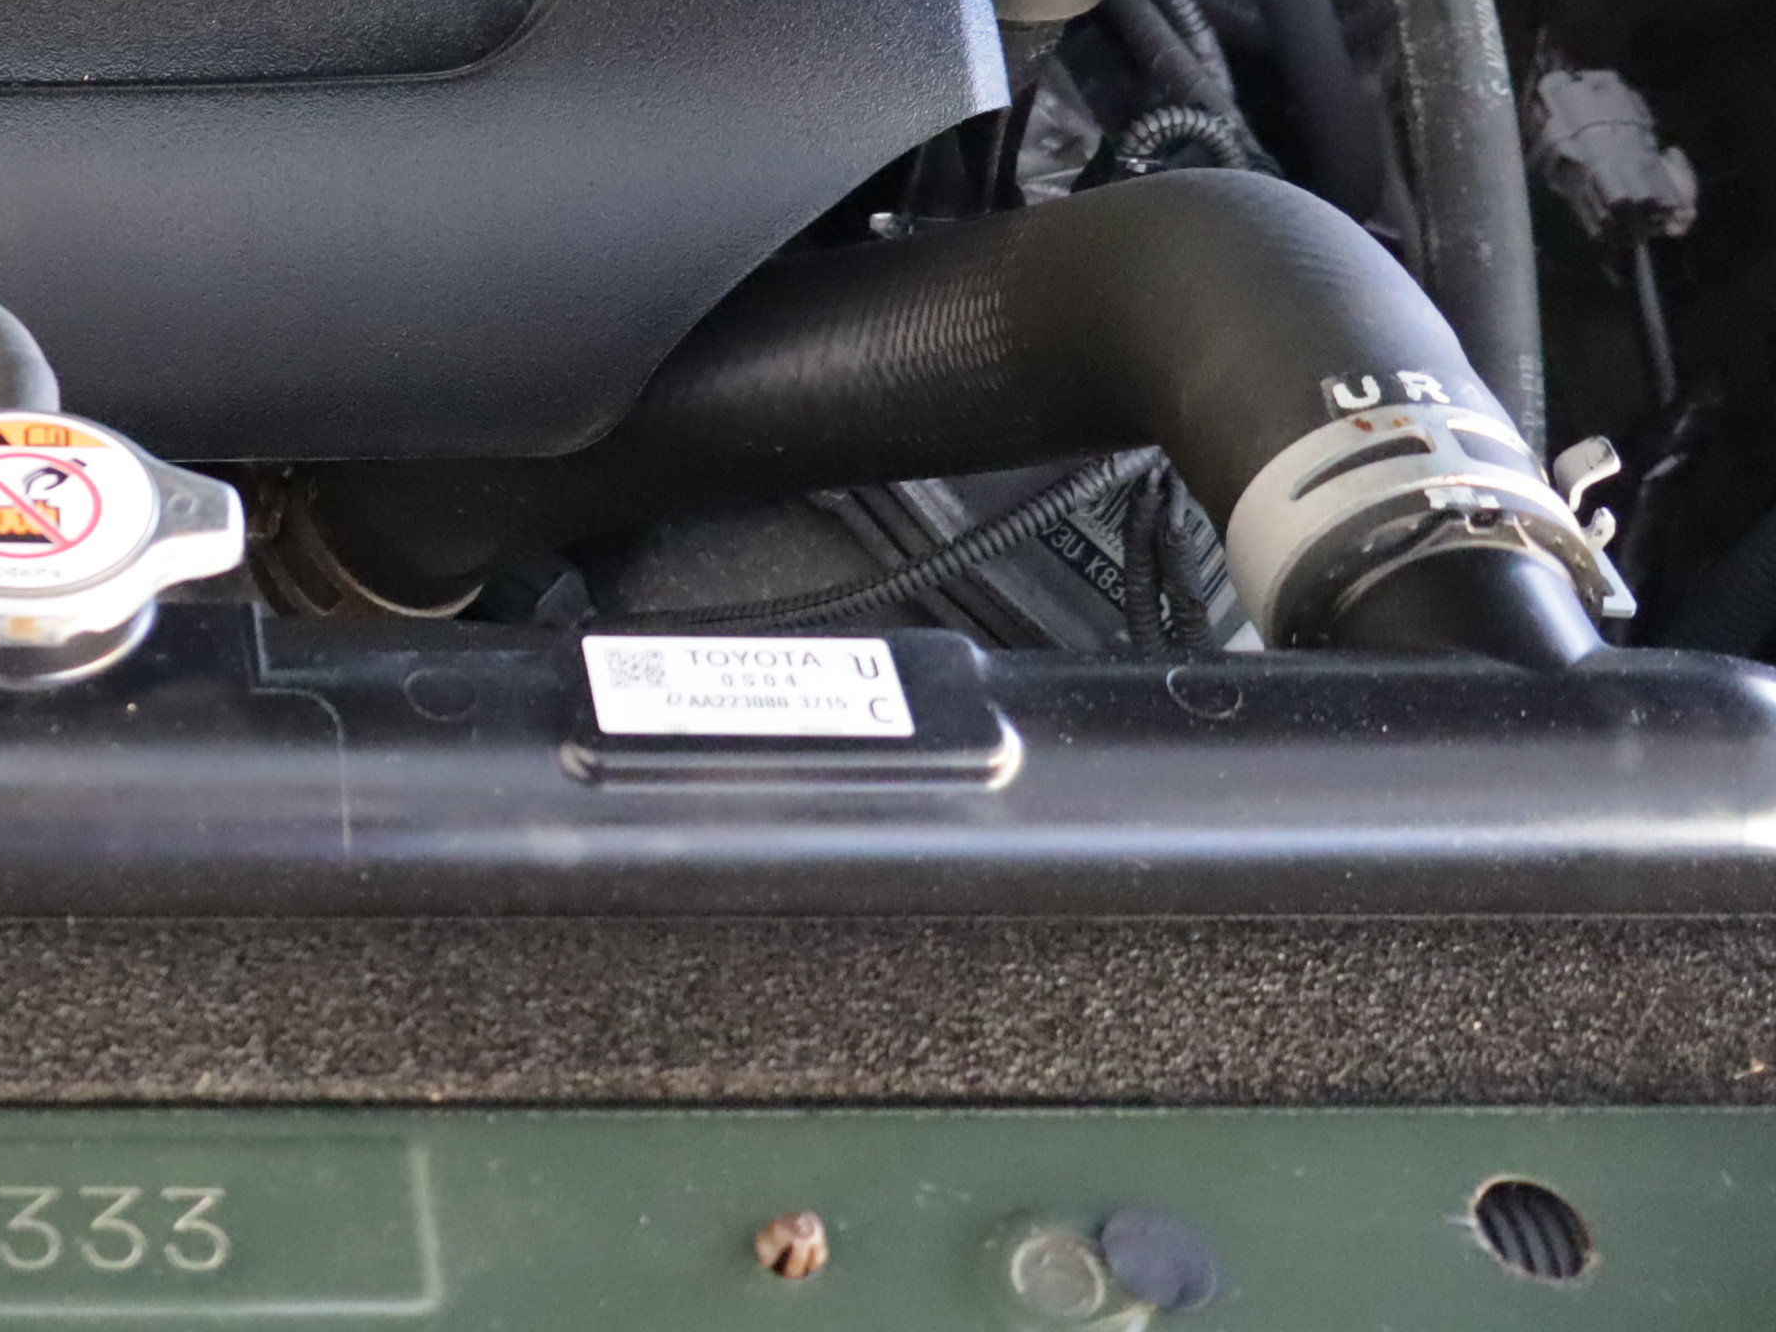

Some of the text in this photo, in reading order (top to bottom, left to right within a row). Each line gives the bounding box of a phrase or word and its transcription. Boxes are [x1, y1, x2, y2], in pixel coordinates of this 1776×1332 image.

[685, 649, 822, 668] TOYOTA
[852, 655, 880, 679] U
[867, 697, 894, 724] C
